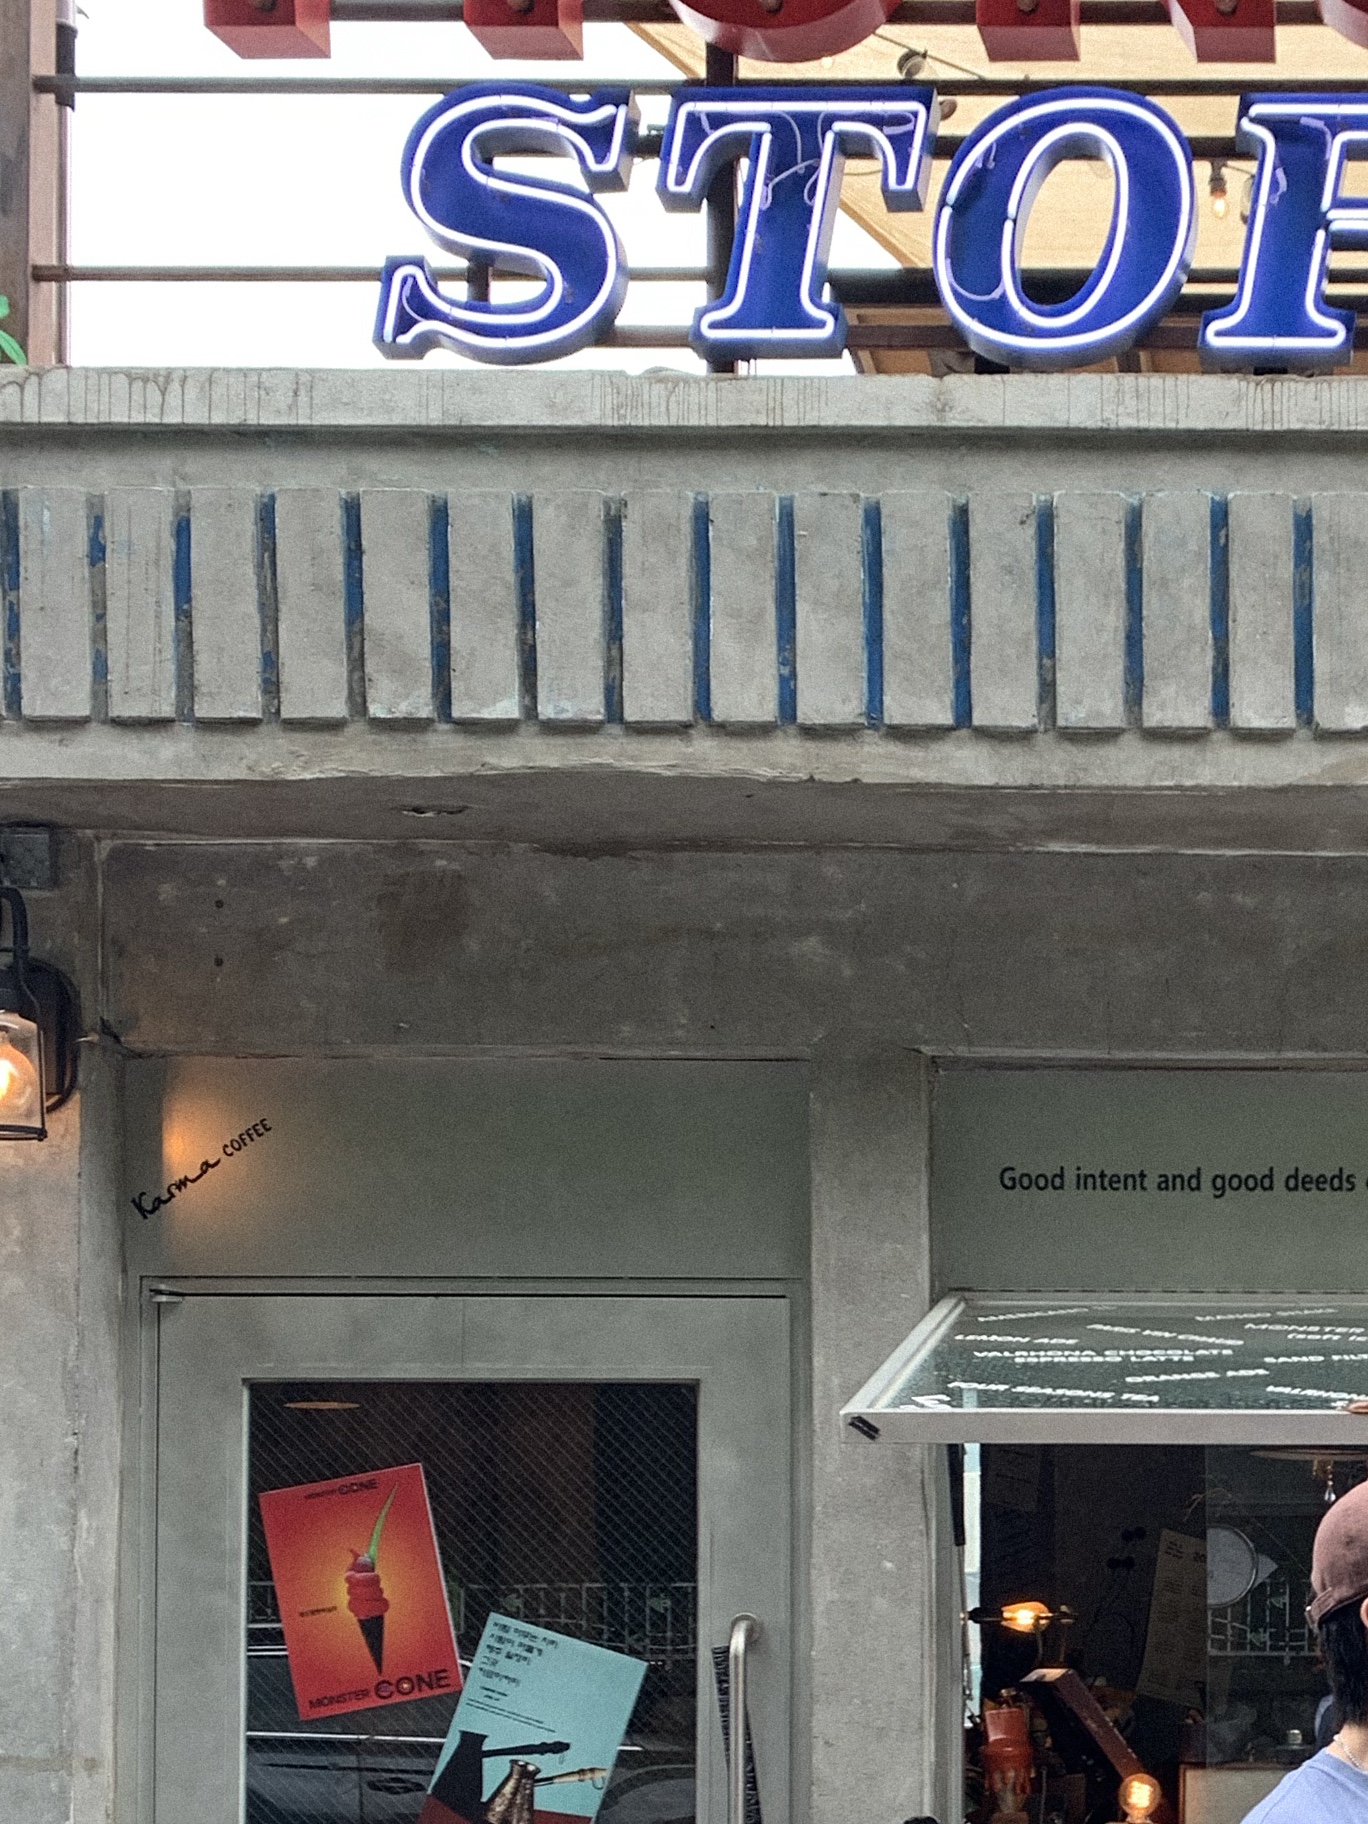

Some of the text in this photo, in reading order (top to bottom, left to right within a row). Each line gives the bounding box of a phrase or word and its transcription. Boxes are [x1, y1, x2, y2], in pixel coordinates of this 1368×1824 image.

[131, 1118, 272, 1219] Karma COFFEE
[999, 1165, 1065, 1192] Good
[1075, 1166, 1148, 1192] intent
[1156, 1166, 1202, 1192] and
[1211, 1166, 1274, 1199] good
[1284, 1166, 1356, 1192] deeds
[1244, 1323, 1365, 1334] MONSTER
[974, 1348, 1234, 1357] VALRHONA CHOCOLATE
[1014, 1355, 1195, 1363] ESPRESSO LATTE
[308, 1687, 369, 1710] MONSTER
[374, 1669, 450, 1700] CONE
